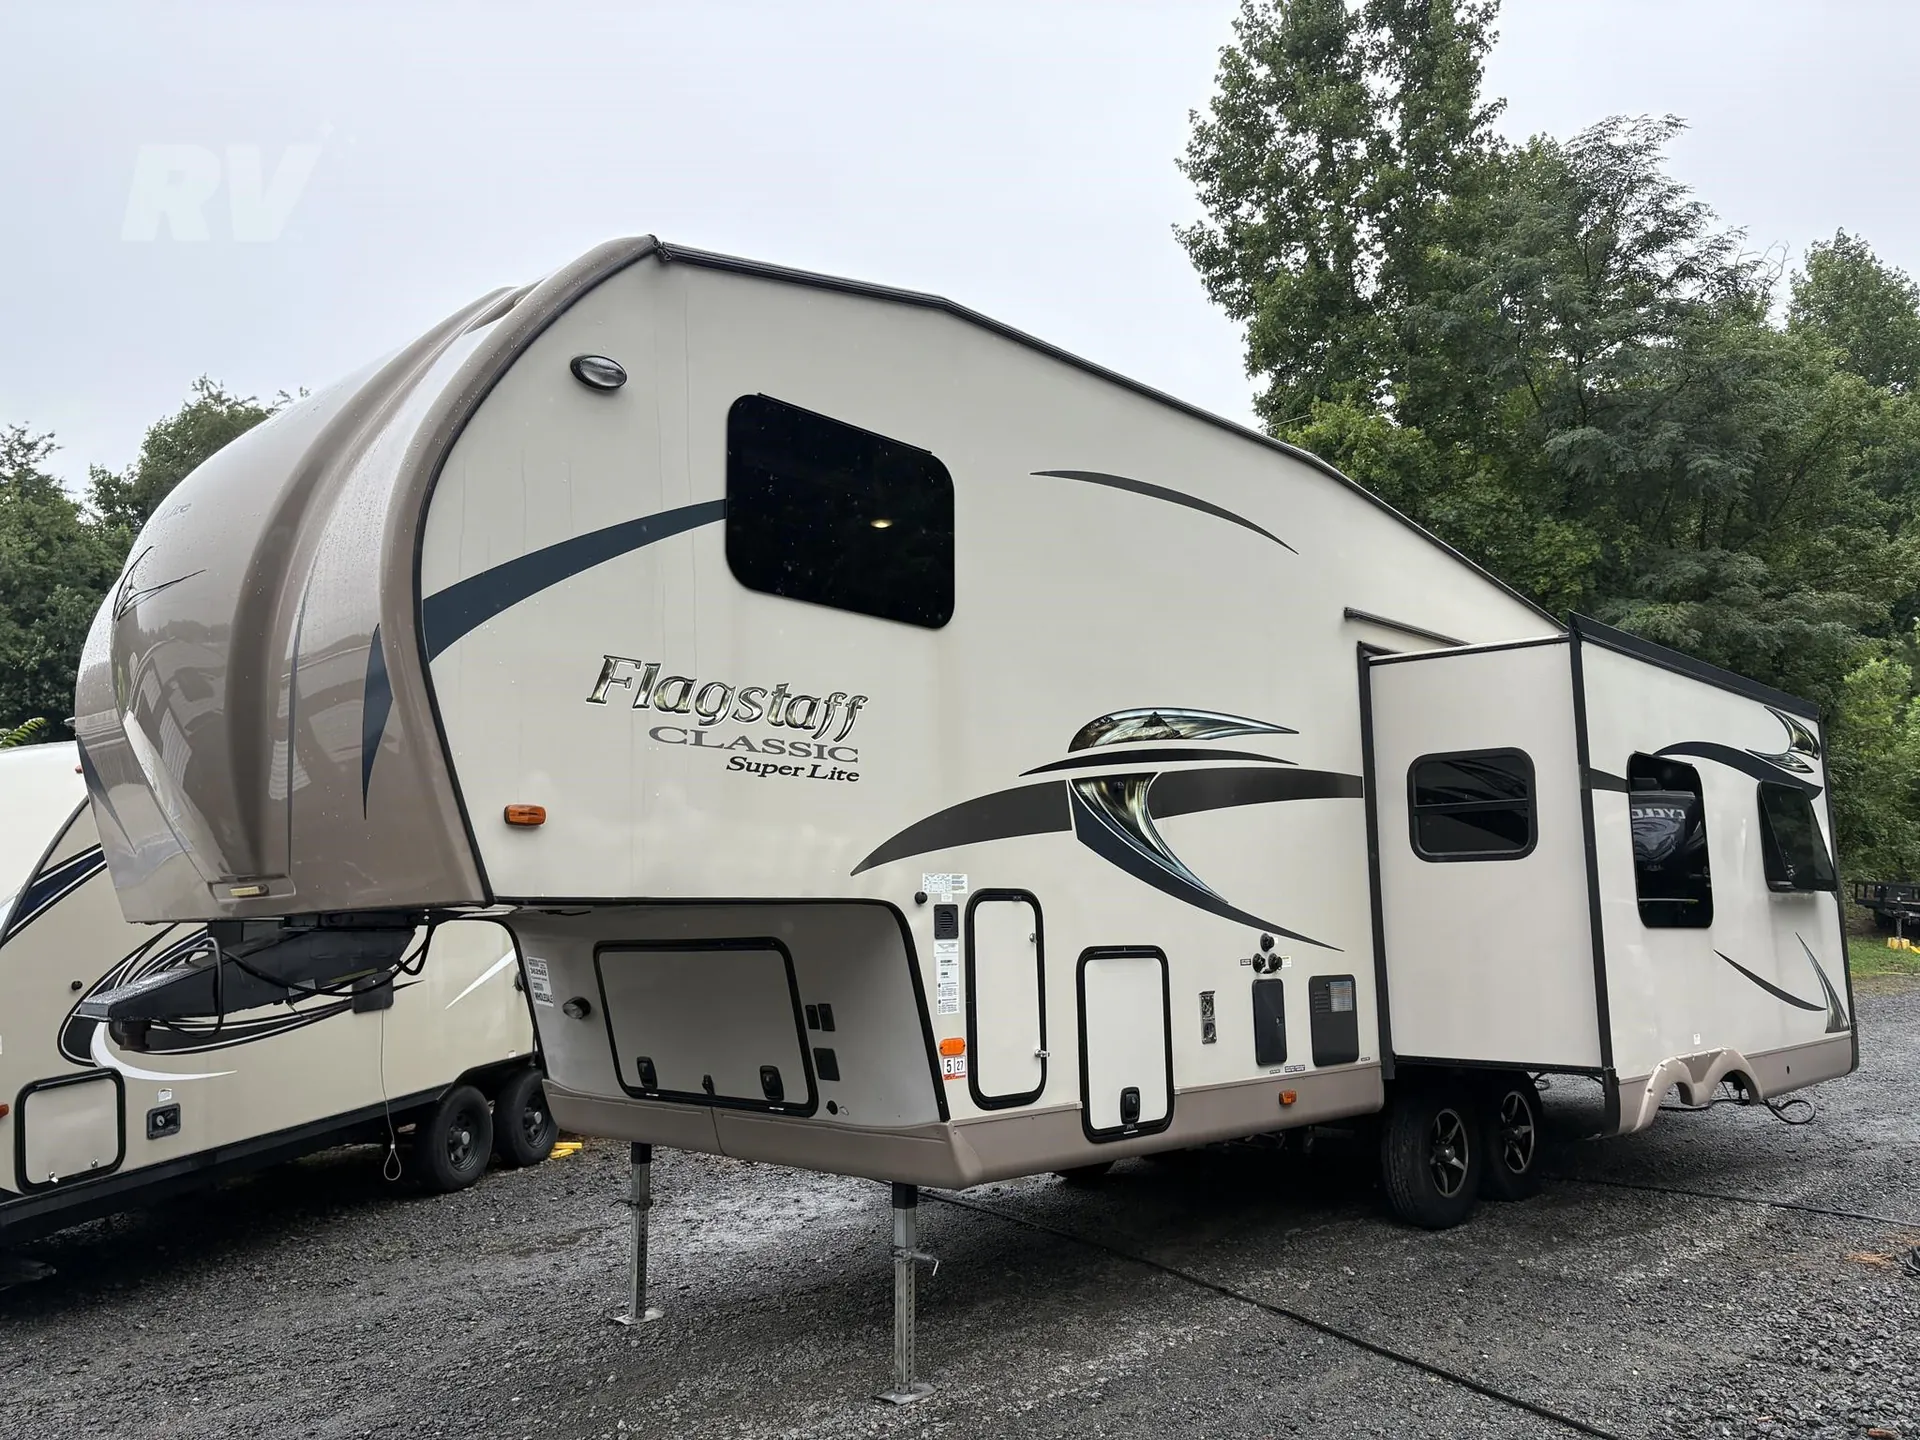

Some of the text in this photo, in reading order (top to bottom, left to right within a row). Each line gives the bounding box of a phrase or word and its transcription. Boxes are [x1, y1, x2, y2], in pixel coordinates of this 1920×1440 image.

[586, 654, 868, 742] Flagstaff
[648, 726, 859, 763] CLASSIC
[726, 756, 860, 782] Super Lite
[946, 1059, 964, 1073] 5 27
